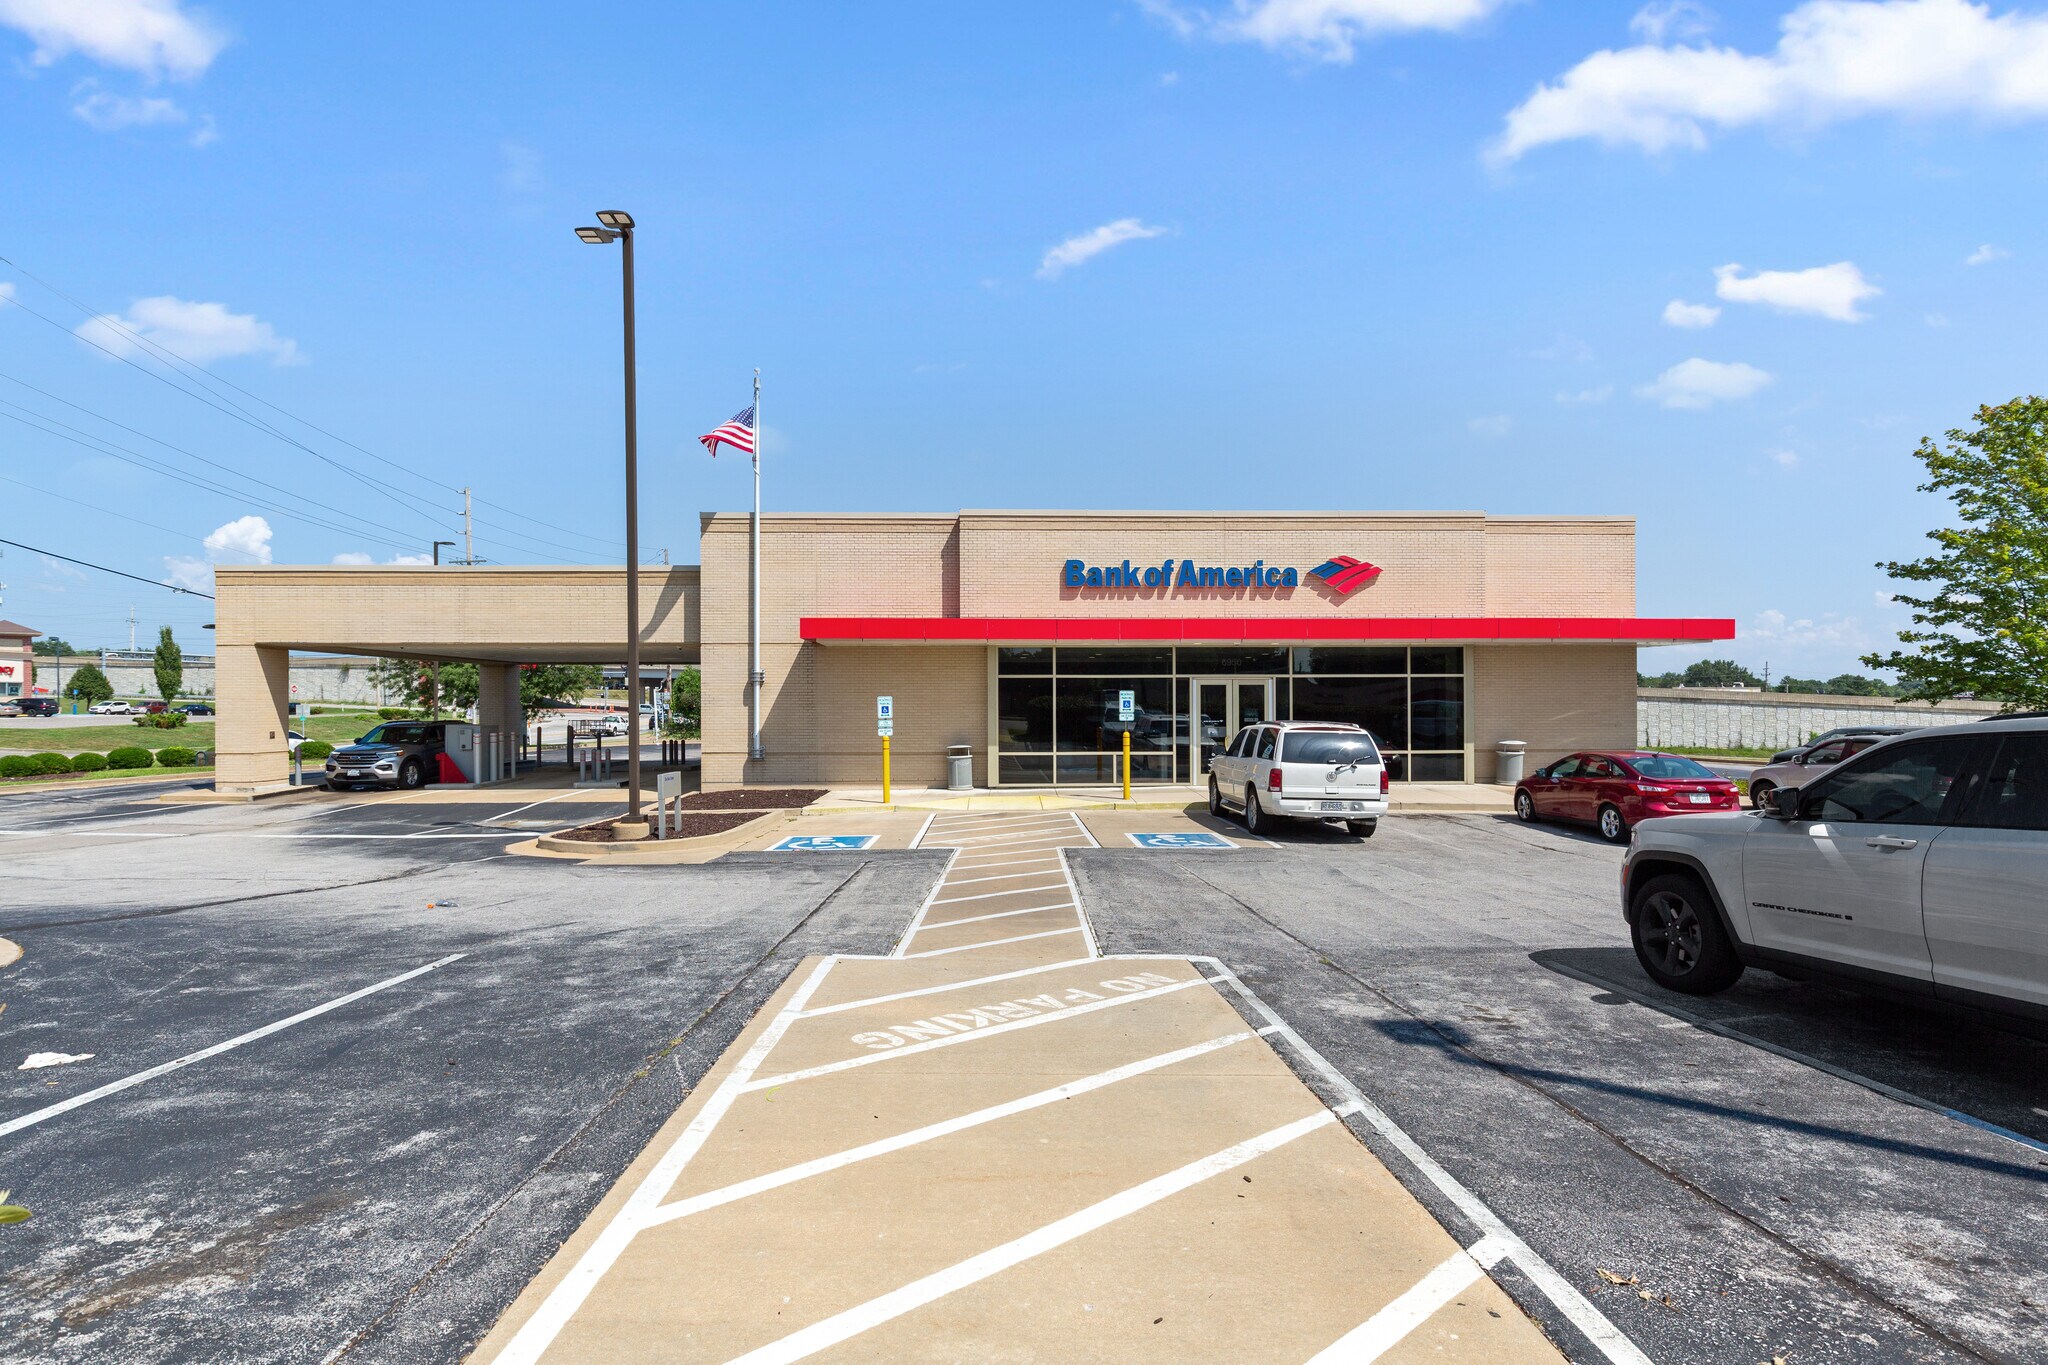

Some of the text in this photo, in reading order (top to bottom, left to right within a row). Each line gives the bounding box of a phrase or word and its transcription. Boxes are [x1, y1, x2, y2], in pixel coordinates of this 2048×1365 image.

[1066, 559, 1298, 587] Bank of America
[1752, 902, 1843, 919] GRAND CHEROKEE
[851, 971, 1179, 1050] NO PARKING
